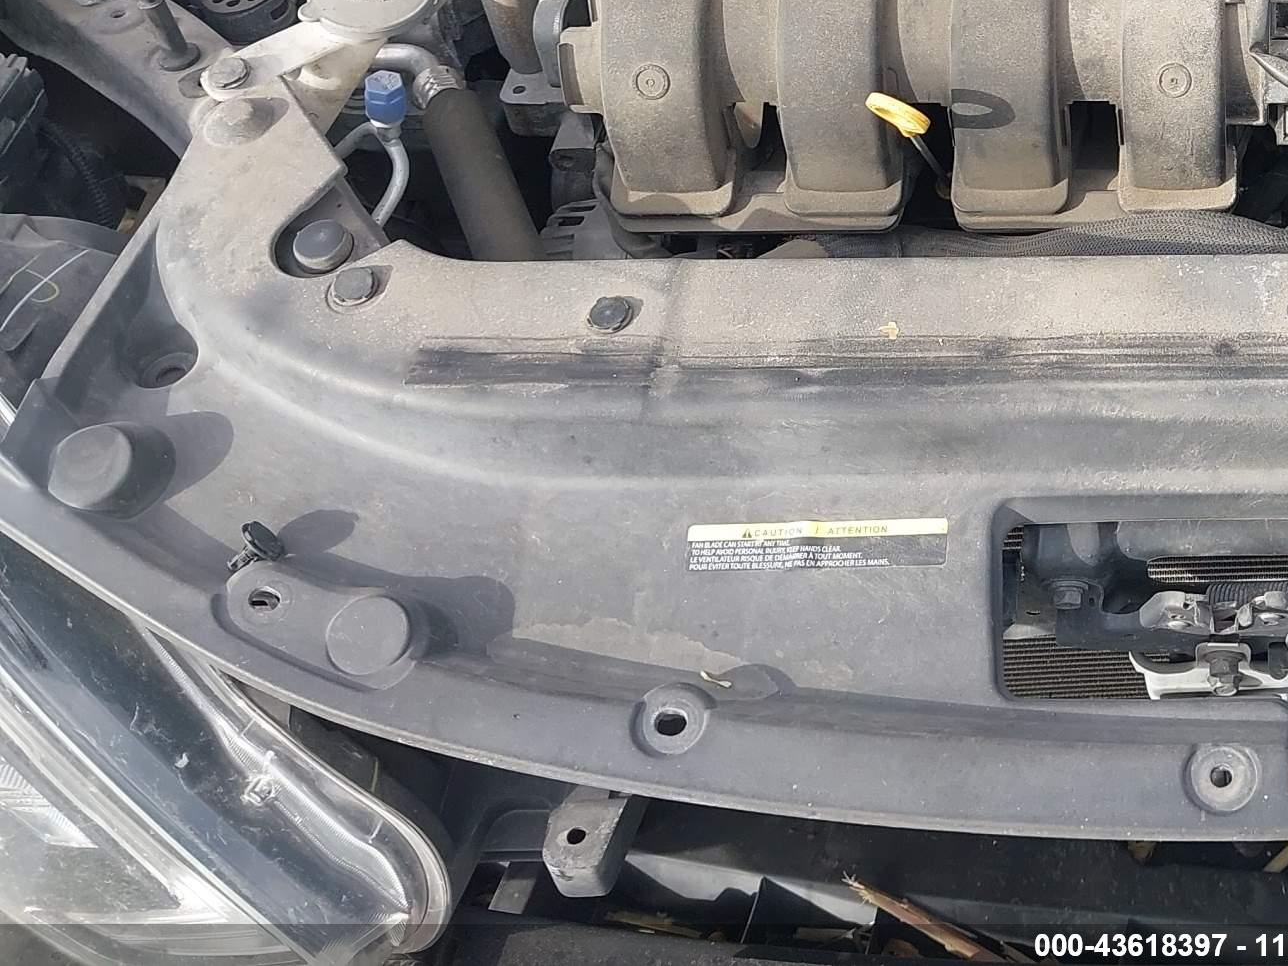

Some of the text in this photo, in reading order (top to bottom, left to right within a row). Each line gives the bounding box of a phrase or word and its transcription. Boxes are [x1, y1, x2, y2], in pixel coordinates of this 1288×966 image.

[754, 527, 803, 537] CAUTION
[828, 525, 888, 535] ATTENTION
[735, 547, 765, 555] PERSONAL
[688, 563, 708, 571] POUR
[708, 561, 731, 571] ÉVITER
[730, 561, 752, 570] TOUTE
[784, 560, 793, 568] NE
[793, 559, 806, 567] PAS
[805, 559, 816, 567] EN
[867, 558, 891, 566] MAINS.
[690, 556, 699, 564] LE
[698, 555, 740, 563] VENTILATEUR
[740, 554, 764, 562] RISQUE
